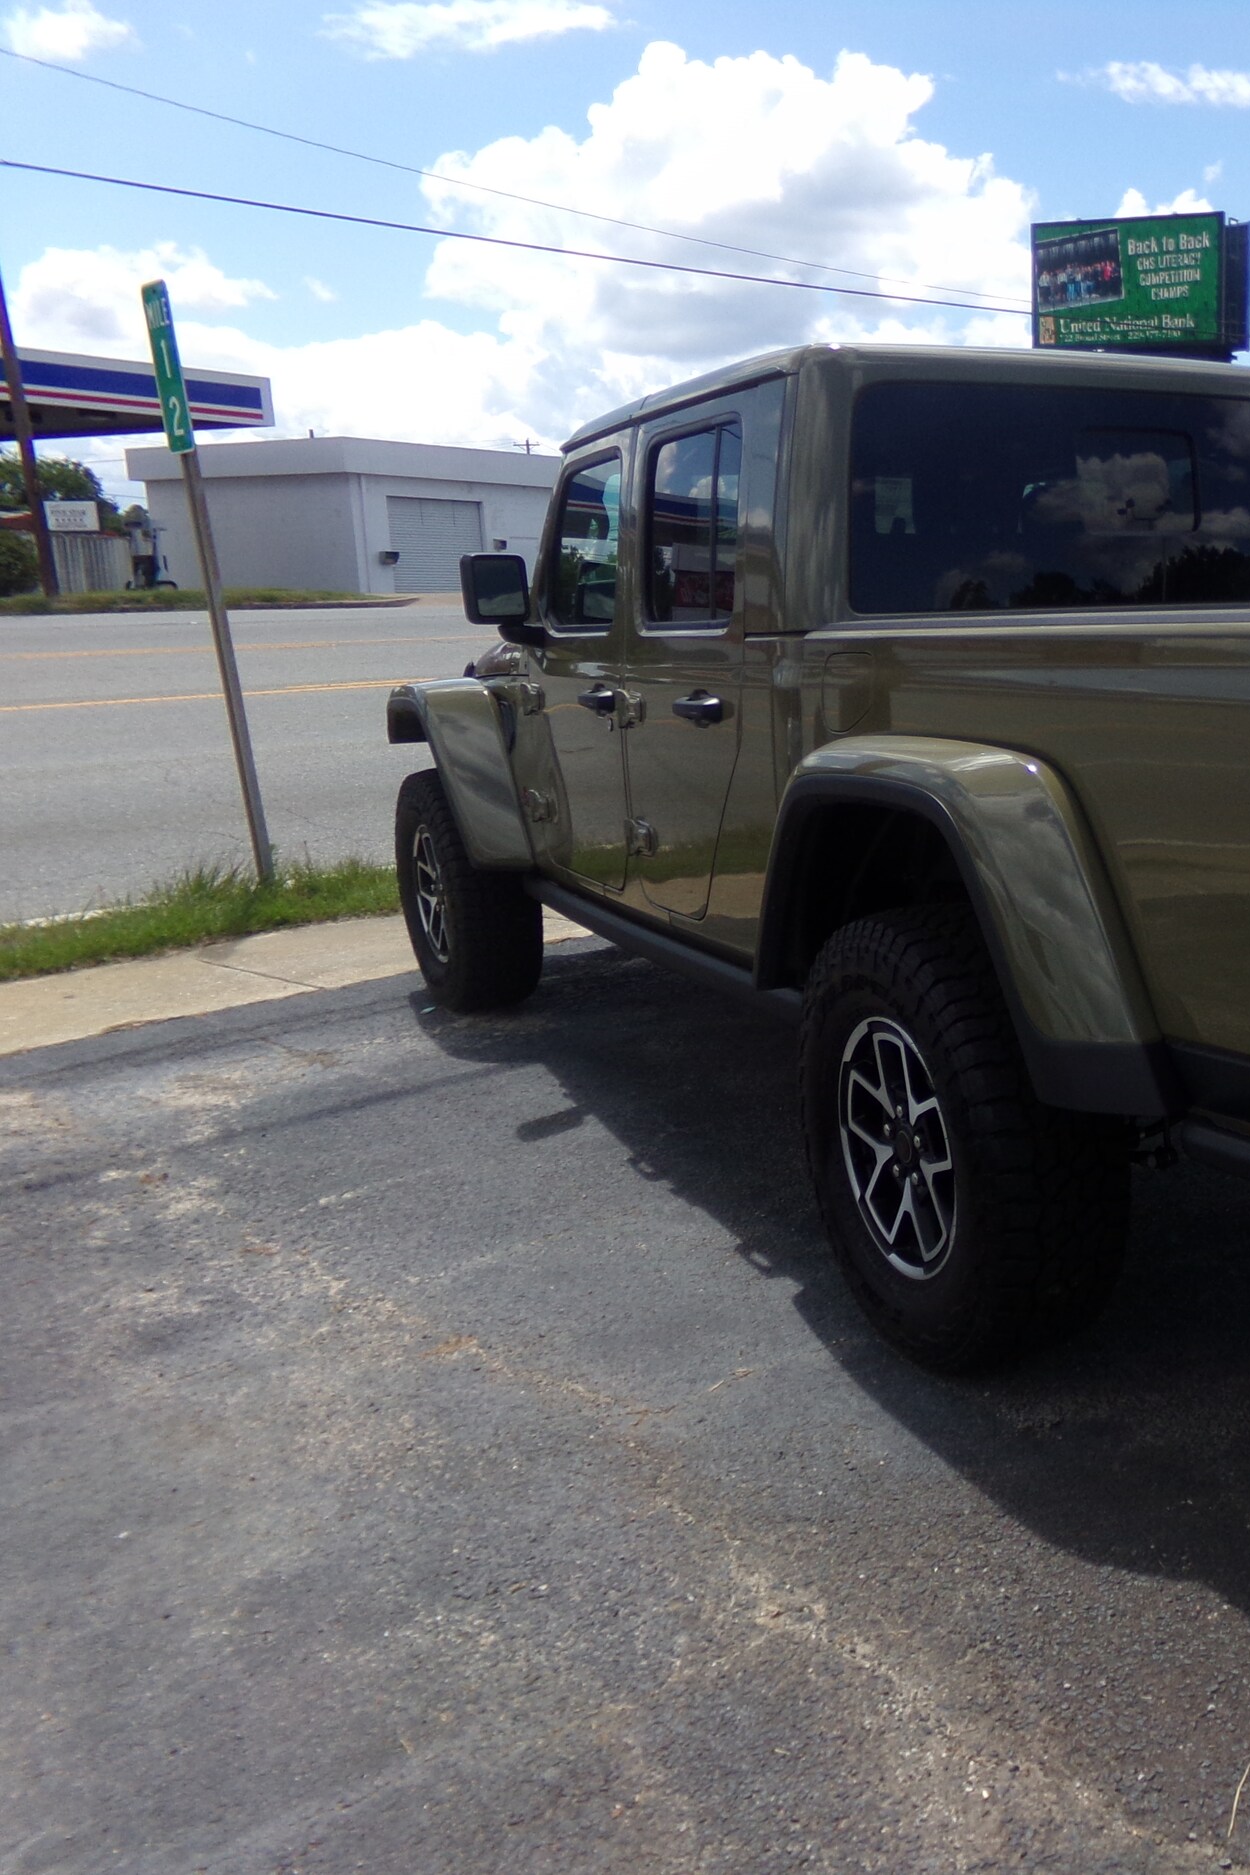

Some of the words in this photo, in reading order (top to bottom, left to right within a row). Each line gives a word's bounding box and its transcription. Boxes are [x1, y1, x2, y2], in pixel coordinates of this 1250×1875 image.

[1128, 236, 1158, 255] Back
[1161, 236, 1175, 251] to
[1179, 231, 1209, 250] Back
[1140, 268, 1200, 286] COMPETITION
[1151, 285, 1189, 300] CHAMPS
[1059, 317, 1101, 333] United
[1104, 315, 1158, 331] National
[1161, 313, 1195, 329] Bank
